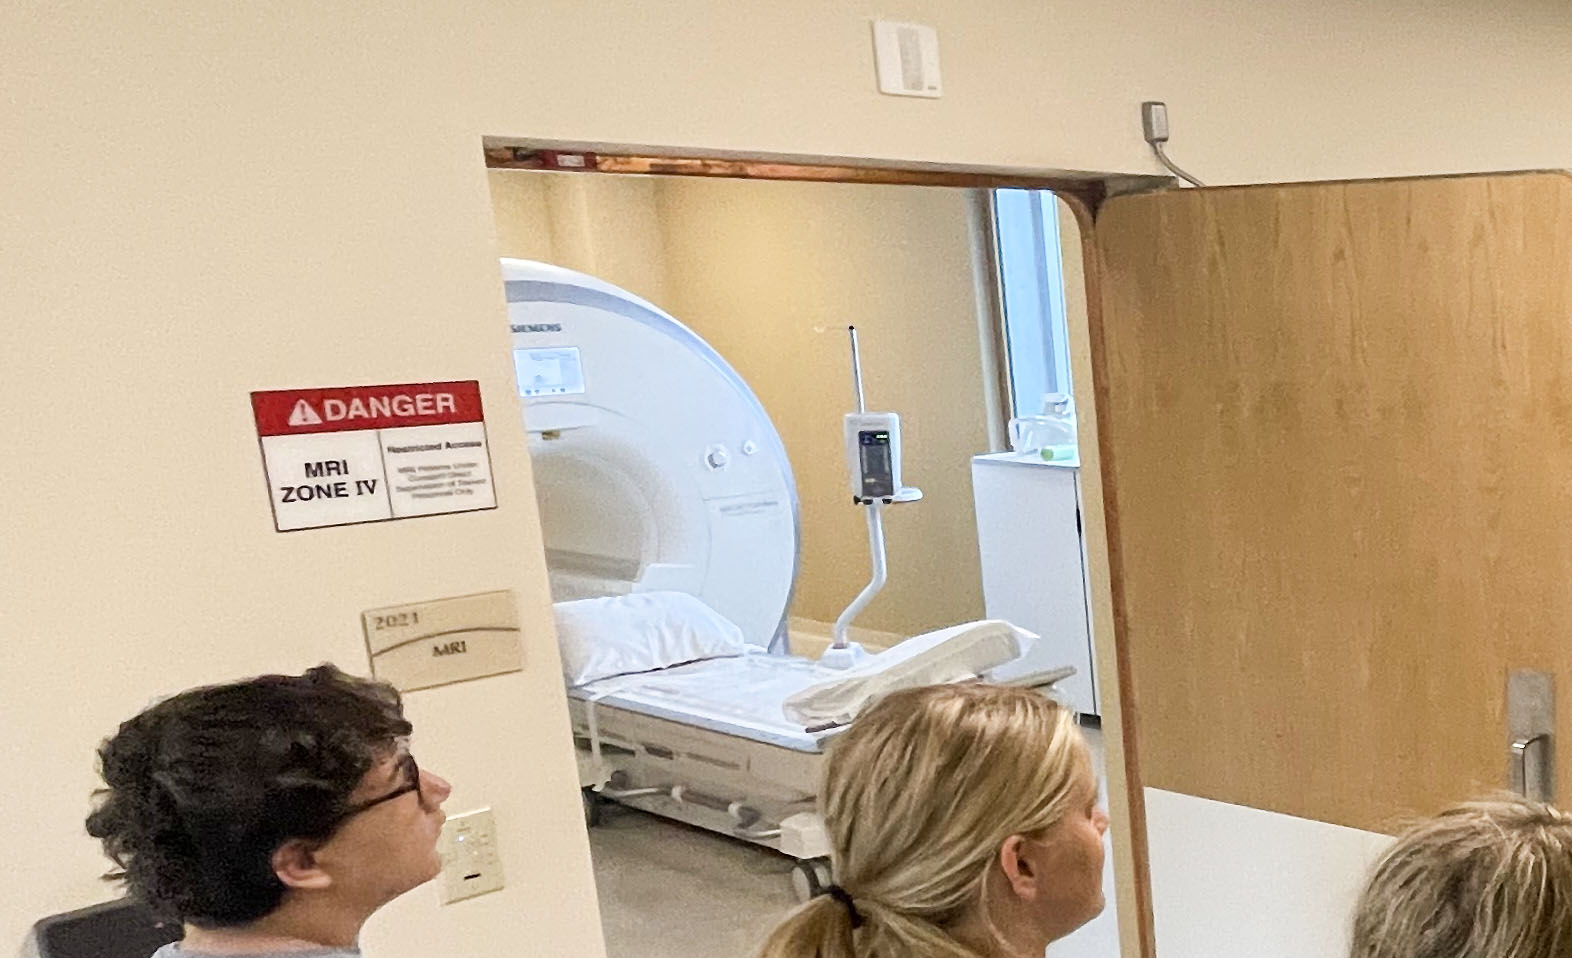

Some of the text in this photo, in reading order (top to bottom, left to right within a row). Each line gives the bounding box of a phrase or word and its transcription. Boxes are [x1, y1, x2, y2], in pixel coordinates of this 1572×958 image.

[323, 392, 457, 422] DANGER
[304, 459, 349, 479] MRI
[280, 482, 350, 503] ZONE
[355, 479, 378, 496] IV
[373, 611, 419, 631] 2021
[432, 640, 467, 658] MRI
